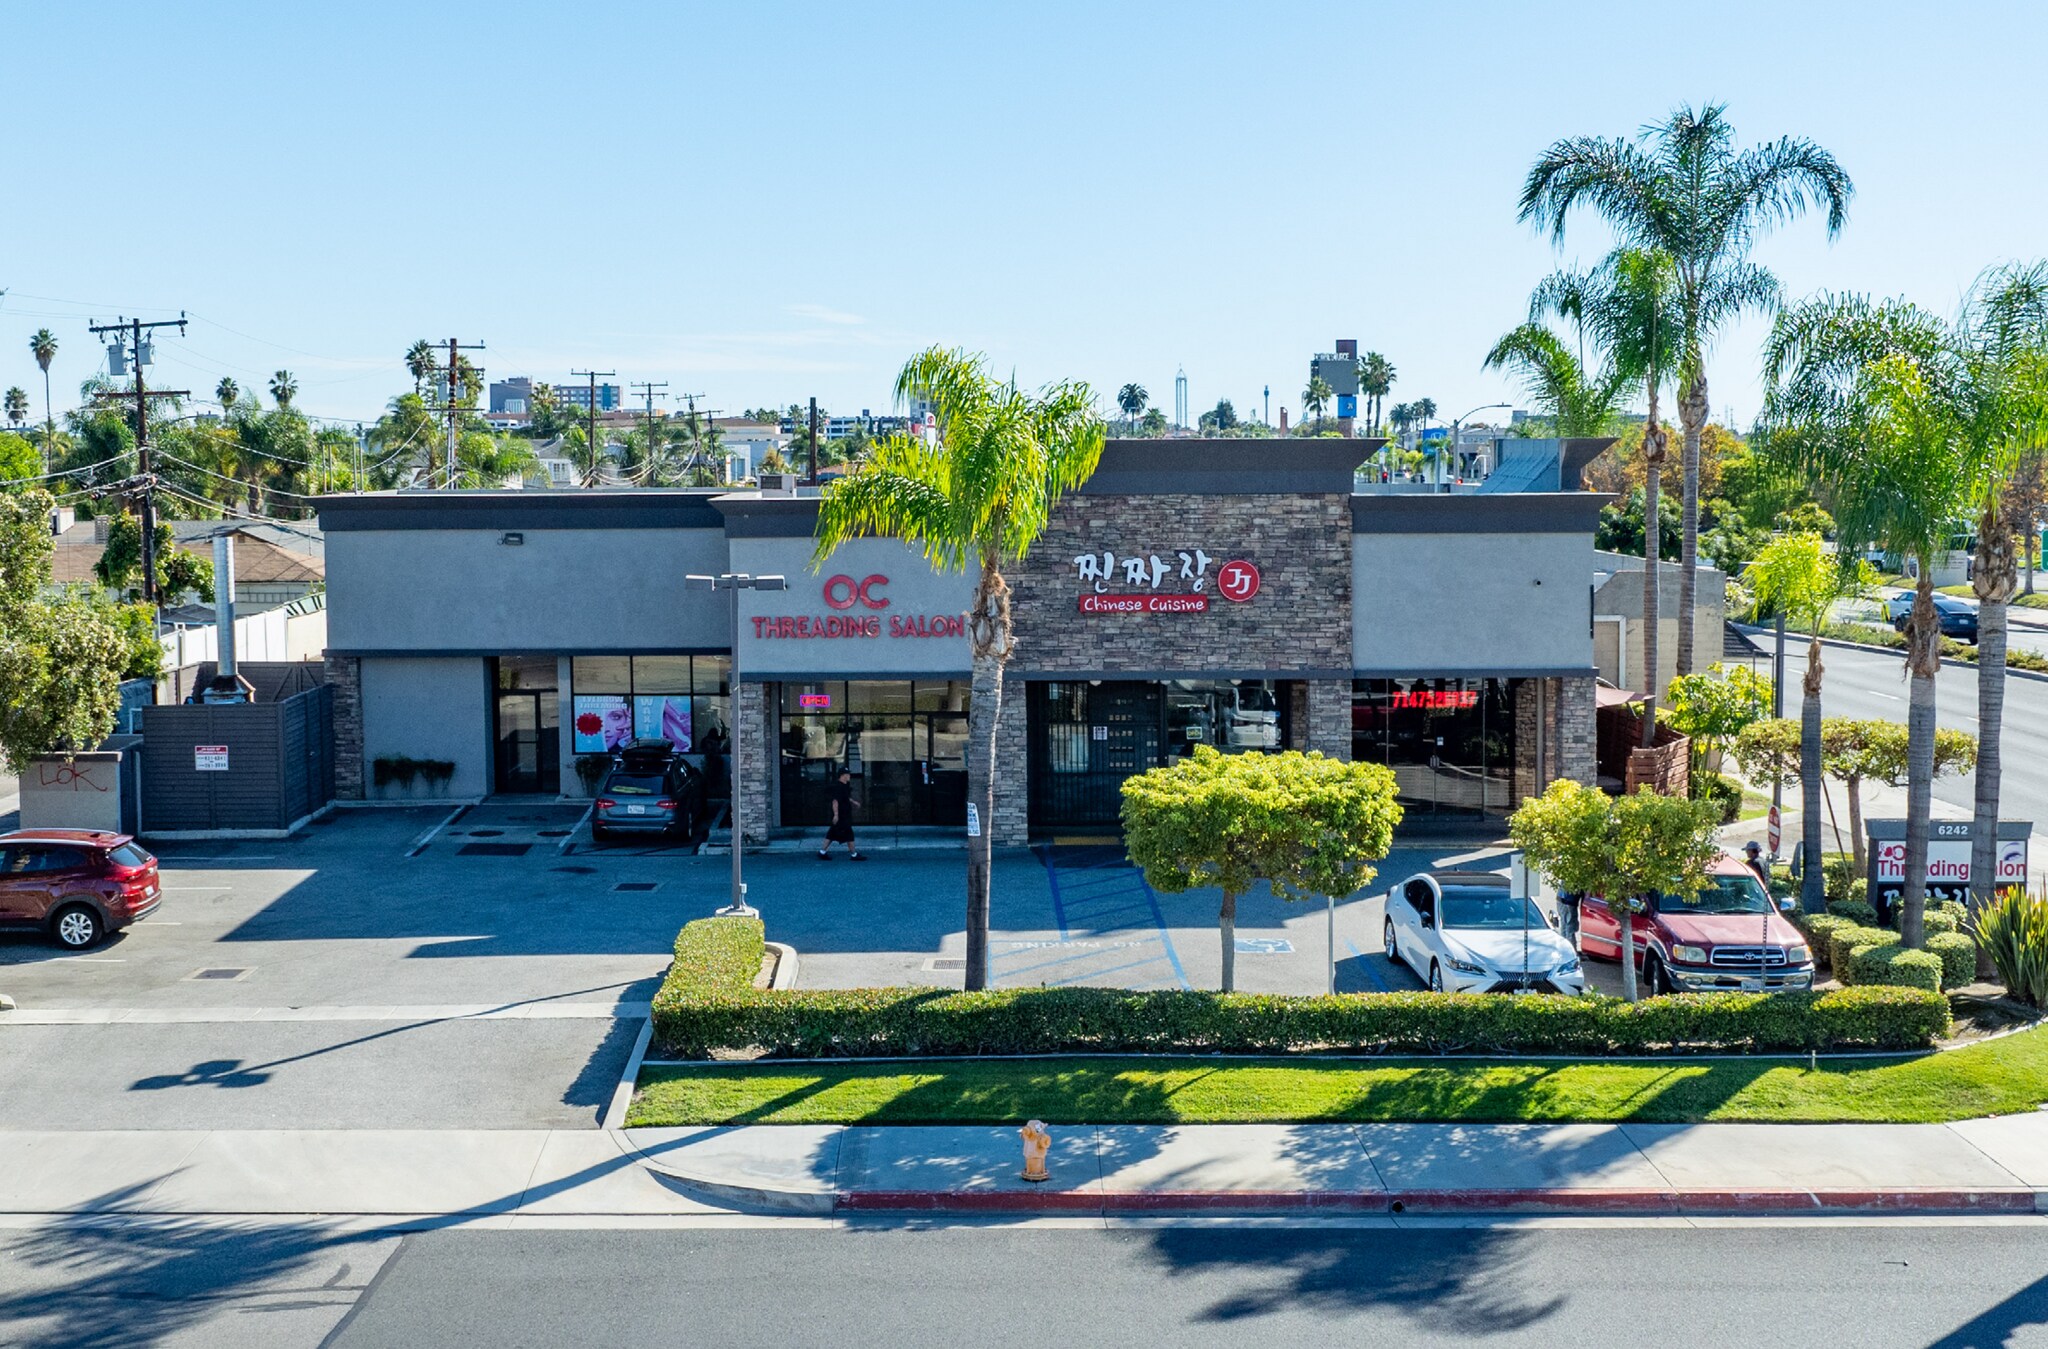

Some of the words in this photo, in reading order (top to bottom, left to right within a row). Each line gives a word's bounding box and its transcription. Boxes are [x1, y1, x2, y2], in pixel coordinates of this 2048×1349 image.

[1074, 550, 1212, 593] 찐짜장
[823, 574, 891, 610] OC
[1084, 597, 1143, 611] Chinese
[1149, 597, 1205, 611] Cuisine
[752, 615, 881, 639] THREADING
[889, 615, 965, 638] SALON
[1938, 825, 1969, 835] 6242
